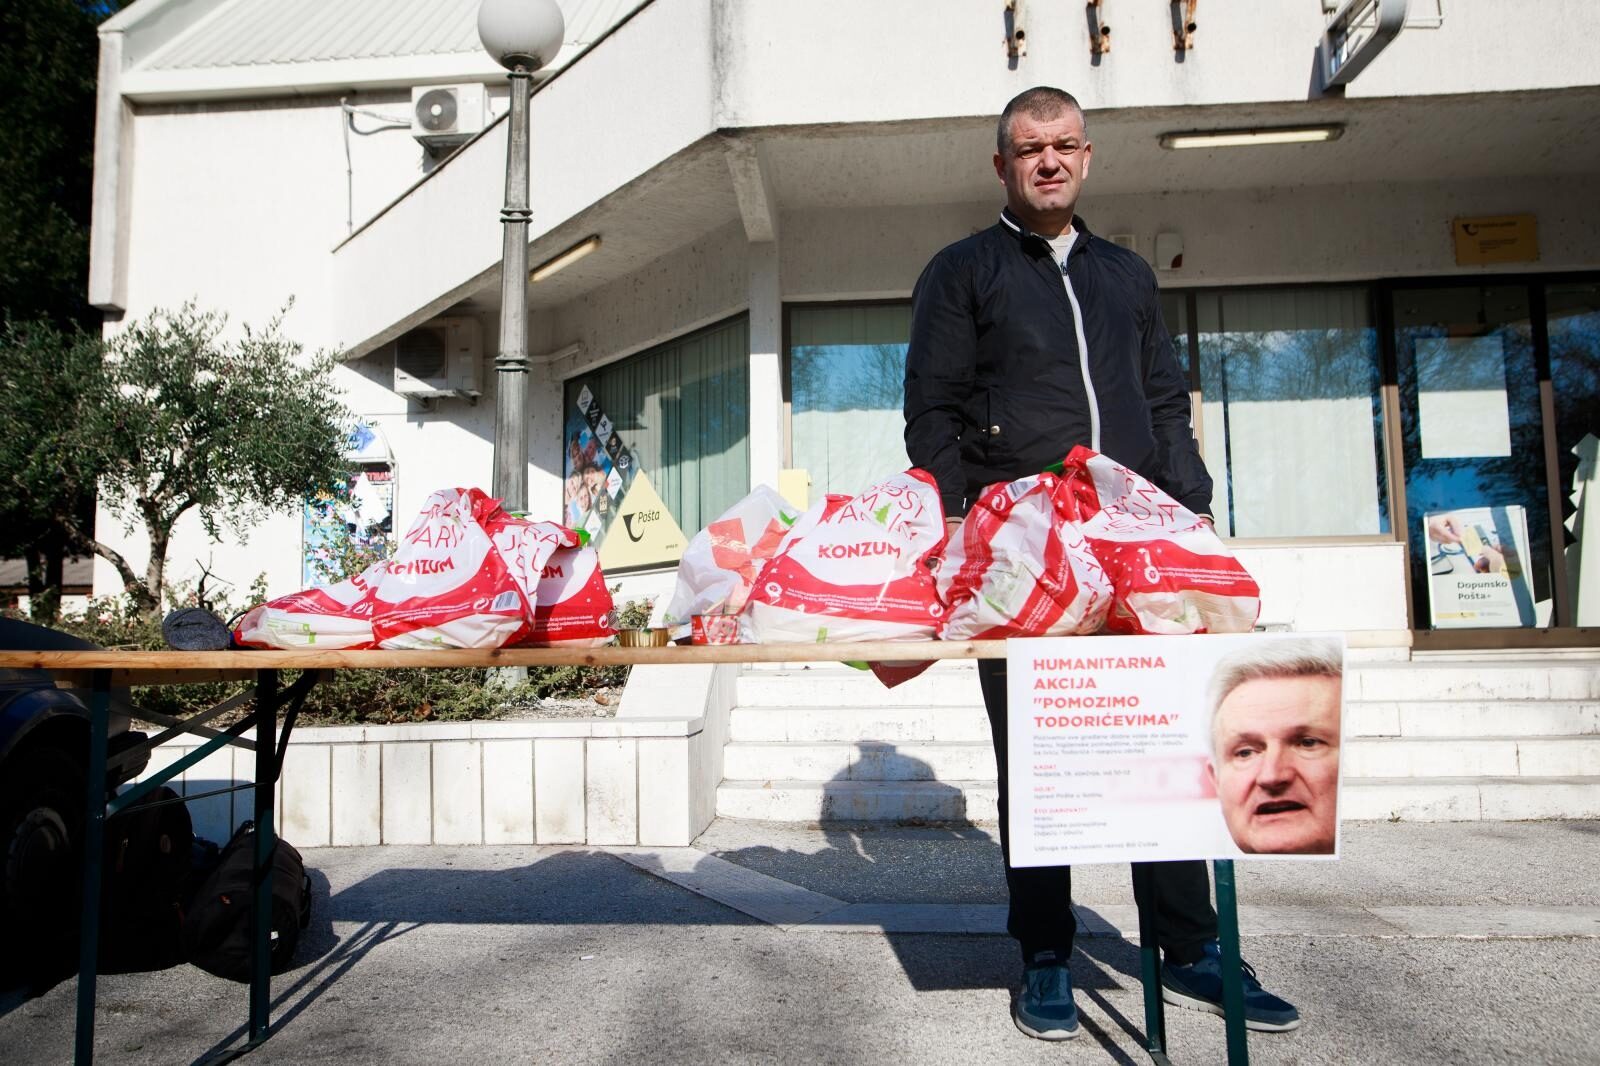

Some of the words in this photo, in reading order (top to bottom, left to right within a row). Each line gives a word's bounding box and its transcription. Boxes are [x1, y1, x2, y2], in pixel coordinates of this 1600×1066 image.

[638, 510, 660, 523] Pošta
[818, 541, 901, 559] KONZUM
[1457, 580, 1508, 590] Dopunsko
[1033, 656, 1166, 671] HUMANITARNA
[1033, 677, 1097, 690] AKCIJA
